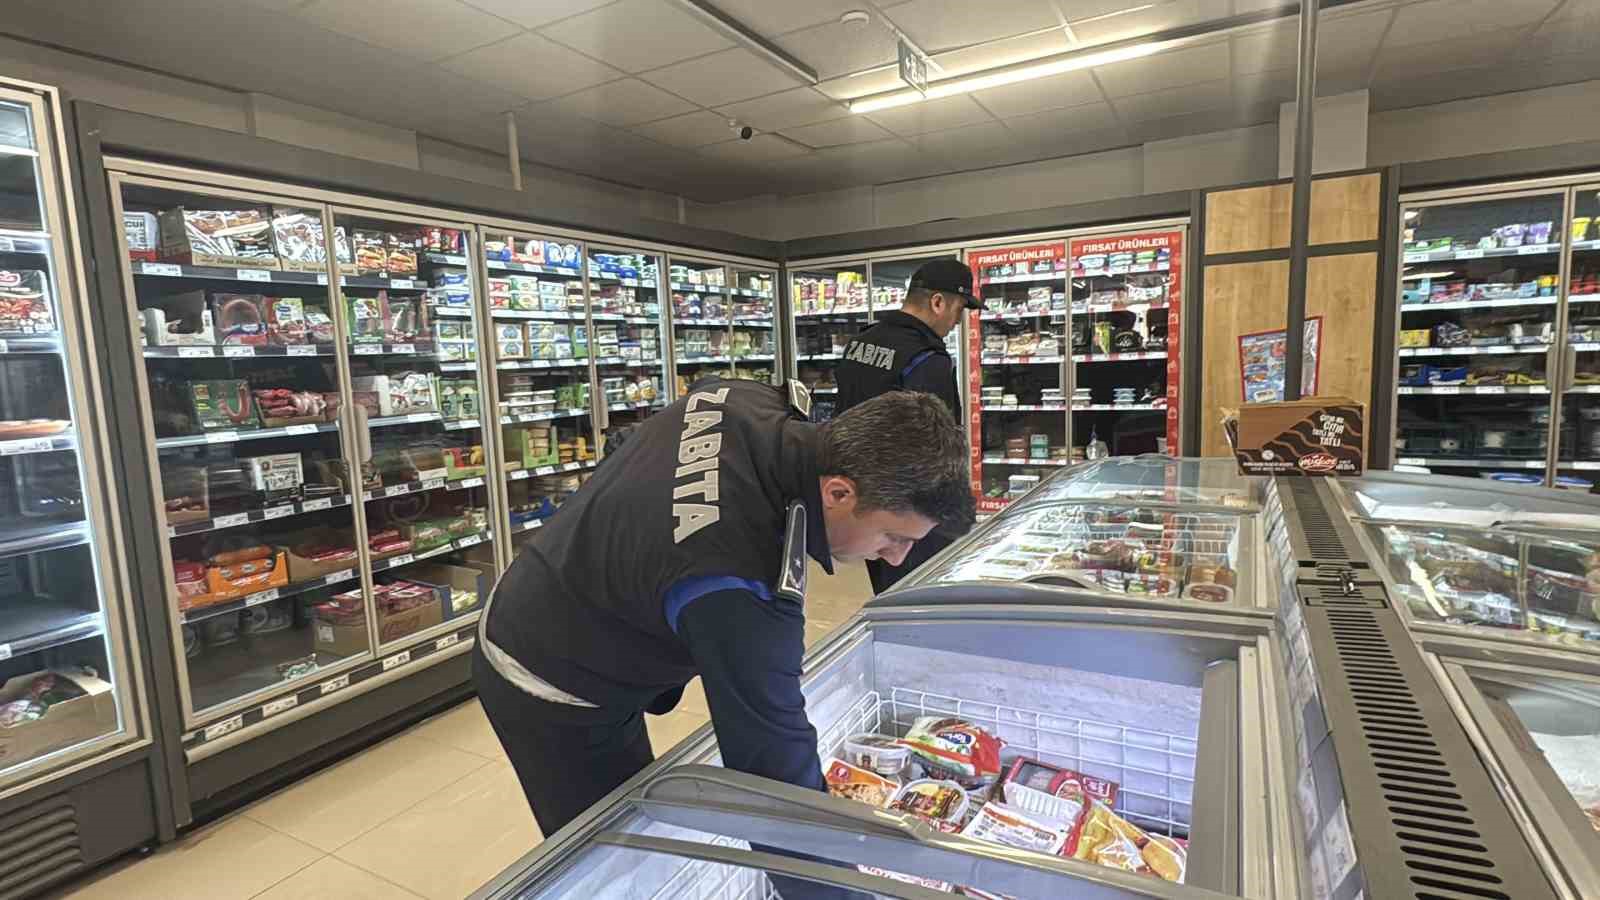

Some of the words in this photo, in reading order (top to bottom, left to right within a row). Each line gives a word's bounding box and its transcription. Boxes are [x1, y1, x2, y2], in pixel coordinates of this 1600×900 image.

[1082, 242, 1116, 254] FIRSAT
[978, 253, 1008, 265] FIRSAT
[847, 340, 896, 370] ZABITA
[672, 387, 730, 544] ZABITA
